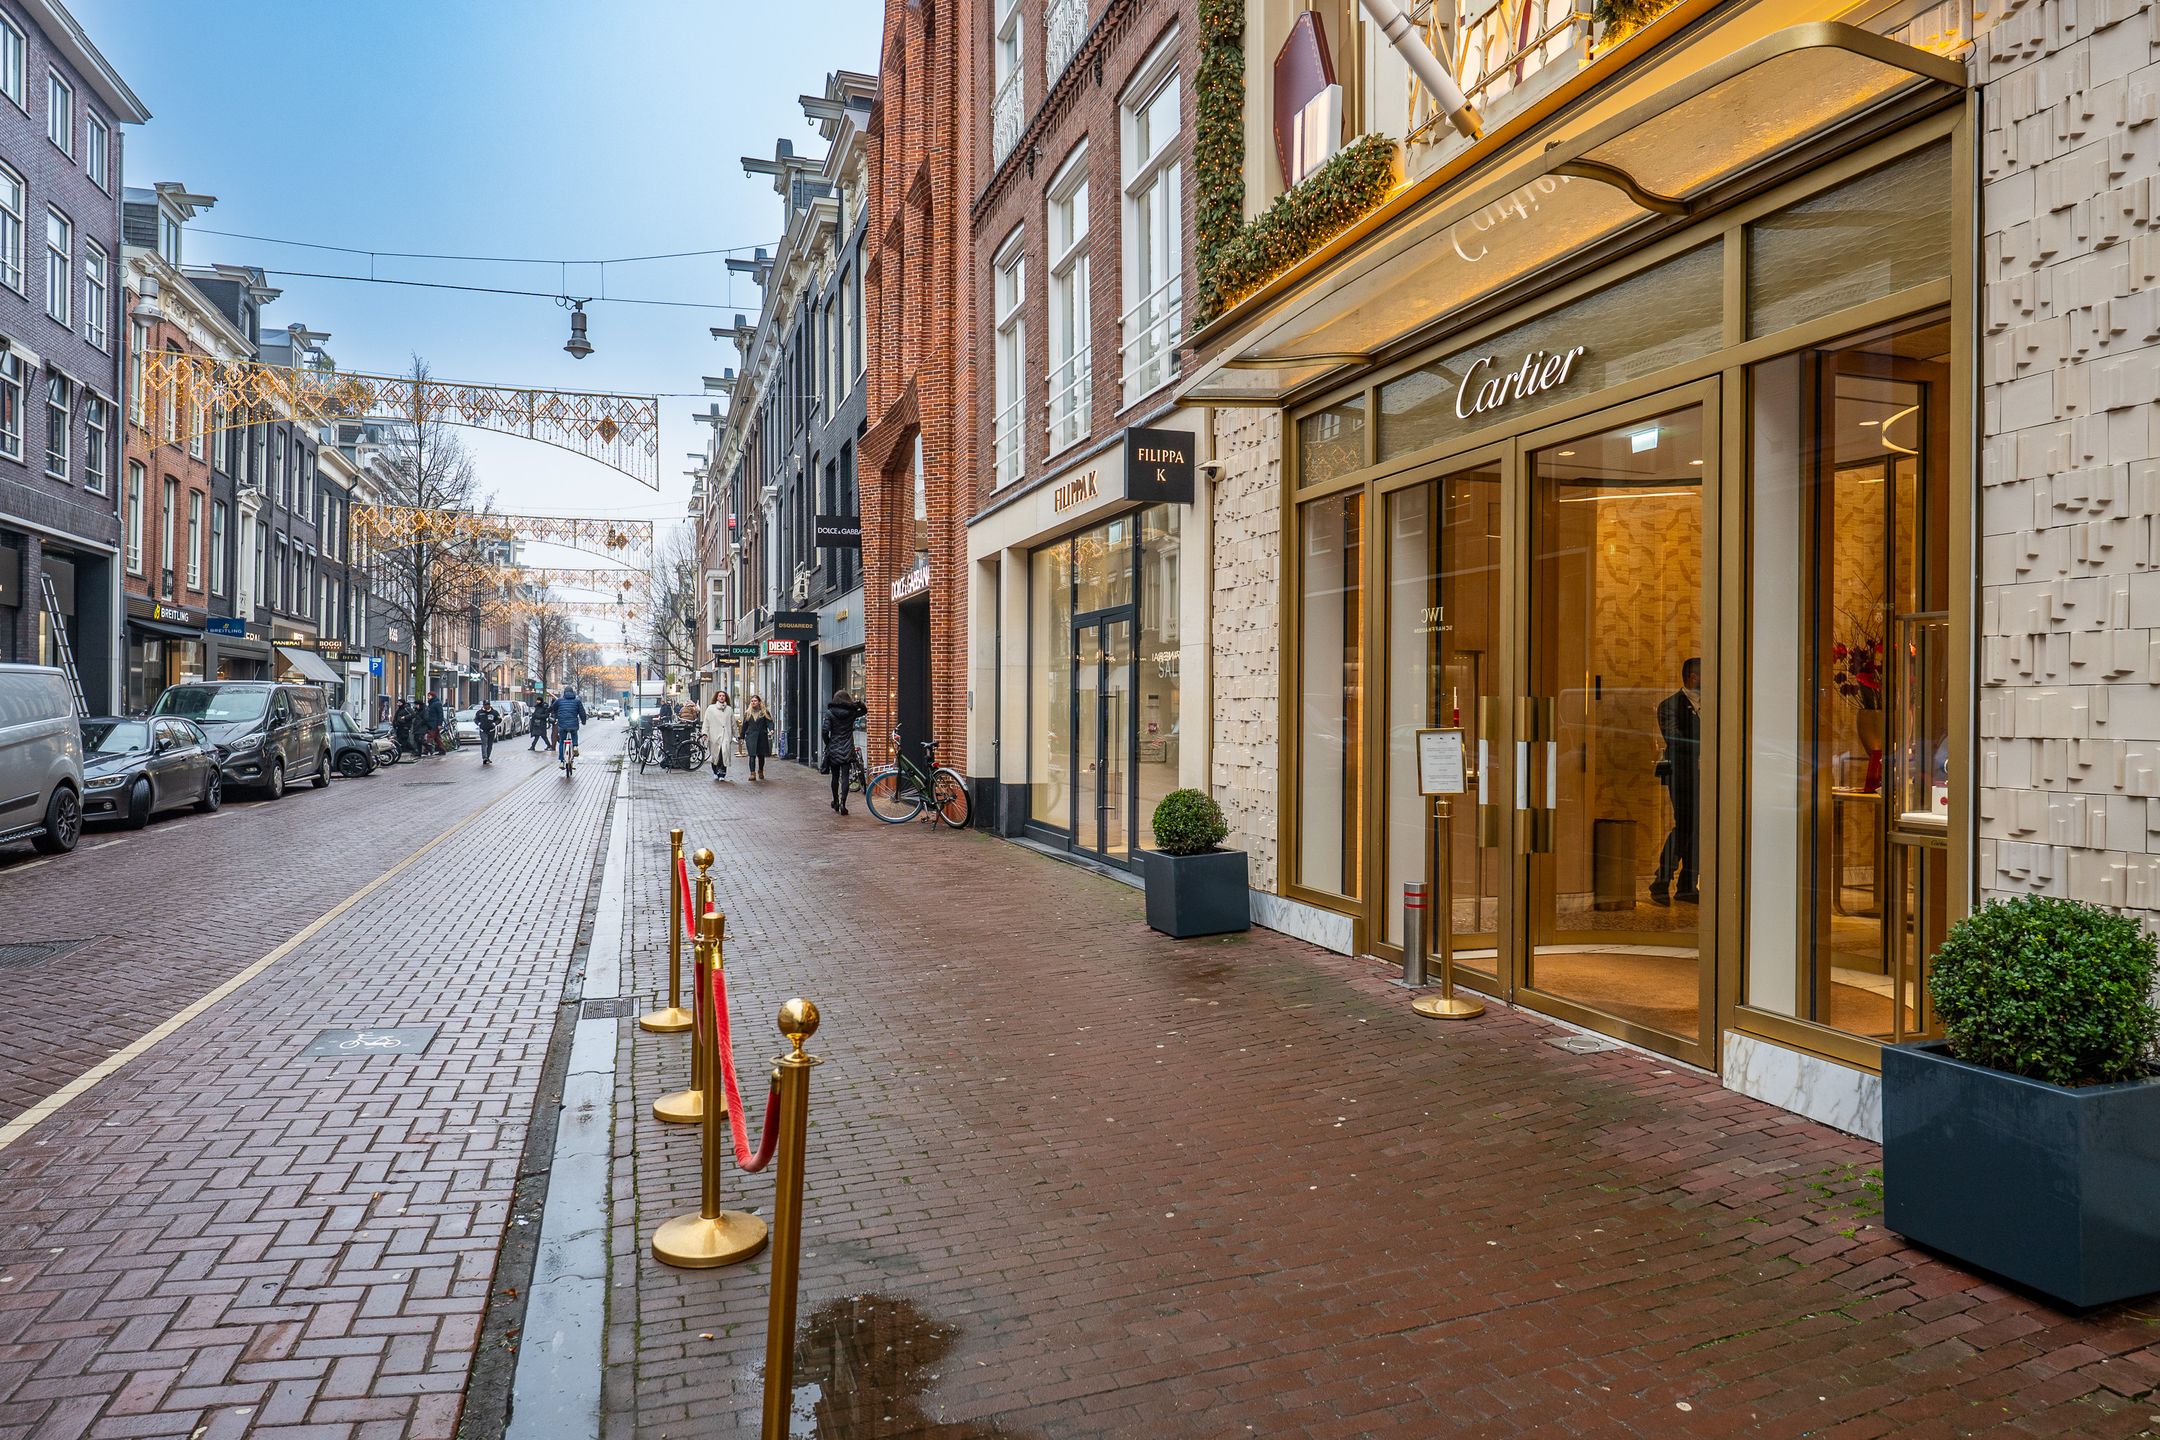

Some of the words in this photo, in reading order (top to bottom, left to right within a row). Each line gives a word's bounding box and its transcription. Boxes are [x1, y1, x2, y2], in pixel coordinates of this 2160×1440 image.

[1455, 345, 1585, 419] Cartier
[1138, 448, 1185, 464] FILIPPA
[1156, 468, 1166, 482] K
[1055, 475, 1088, 513] FILIPPA
[1088, 470, 1098, 496] K
[817, 527, 838, 535] DOLCE
[160, 607, 189, 622] BREITLING
[768, 641, 794, 651] DIESEL
[373, 663, 379, 671] P
[1158, 660, 1180, 679] SAL
